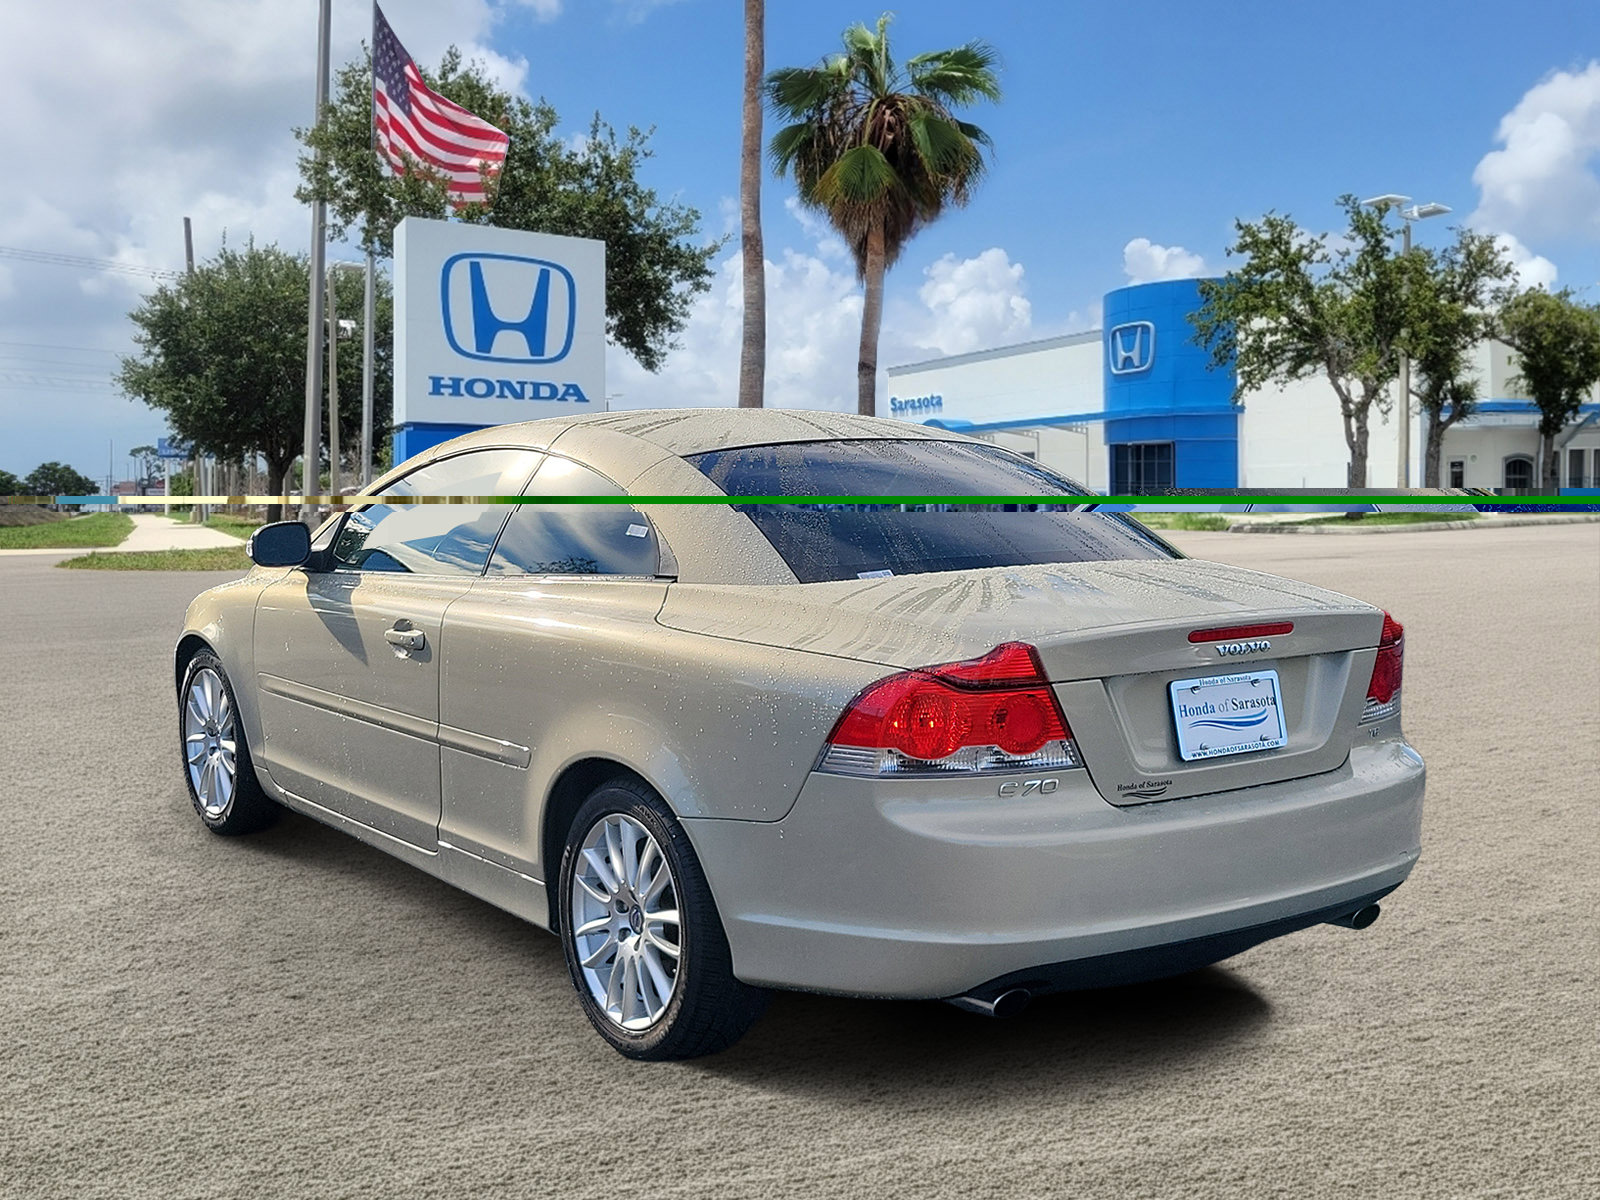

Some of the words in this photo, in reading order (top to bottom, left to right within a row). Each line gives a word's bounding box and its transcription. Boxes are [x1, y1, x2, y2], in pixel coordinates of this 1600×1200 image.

[428, 376, 590, 403] HONDA
[890, 394, 943, 412] Sarasota
[1216, 640, 1271, 656] VOLVO
[1179, 702, 1216, 718] Honda
[1218, 699, 1230, 712] of
[1231, 695, 1276, 711] Sarasota
[1191, 740, 1280, 758] WWW.HONDAOFSARASOTA.COM
[1117, 783, 1137, 791] Honda
[1138, 781, 1146, 789] of
[1146, 780, 1173, 788] Sarasota
